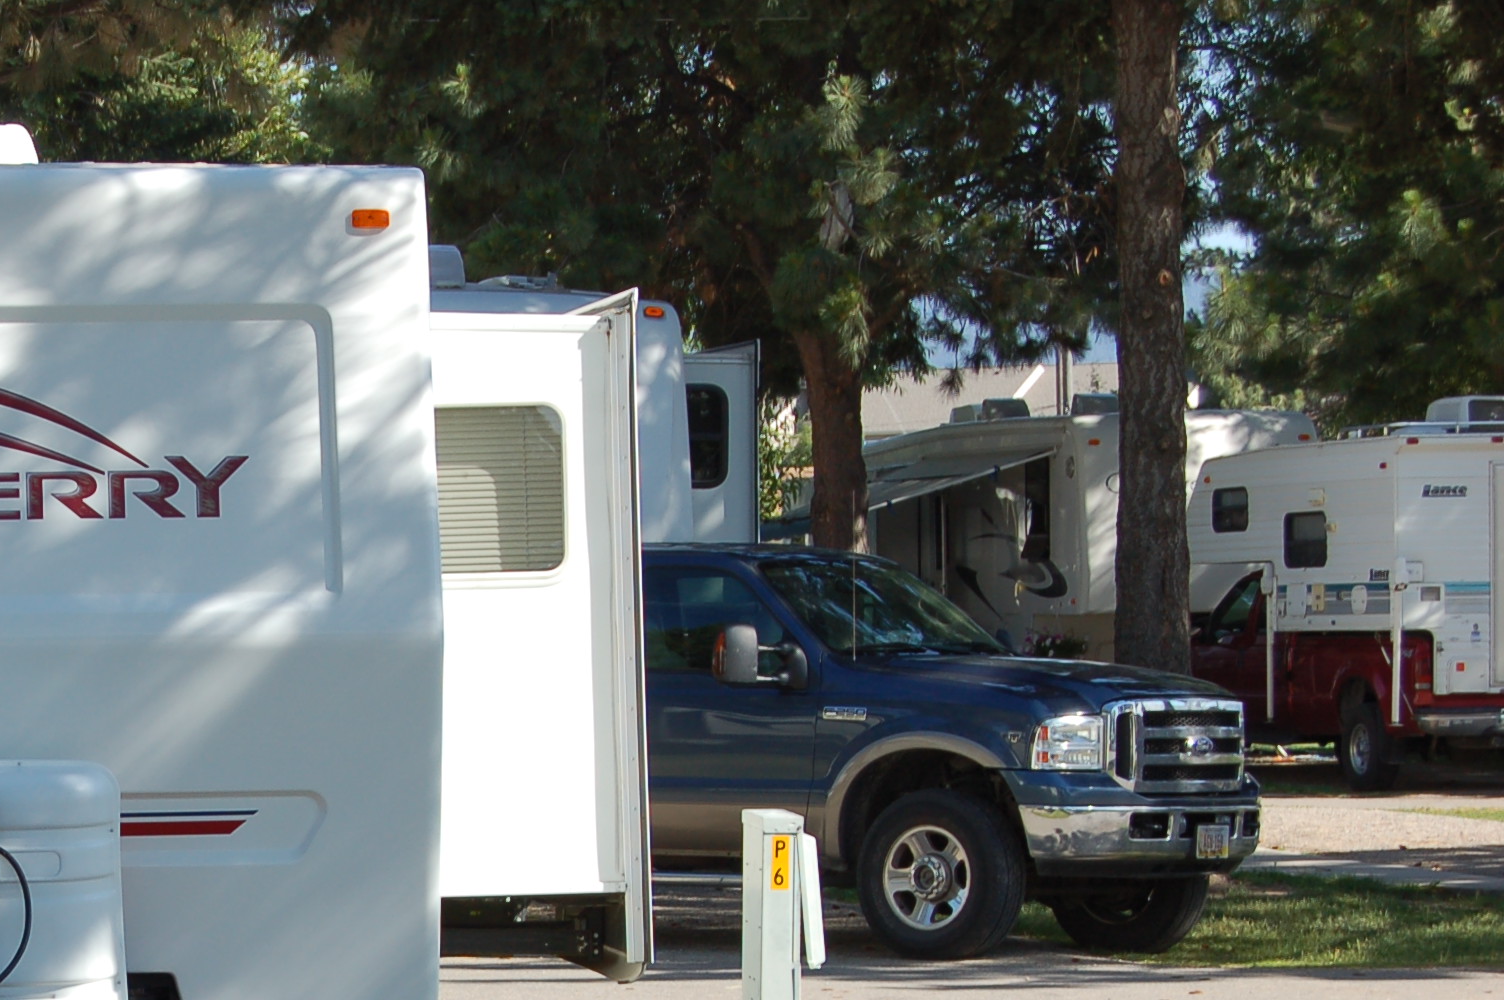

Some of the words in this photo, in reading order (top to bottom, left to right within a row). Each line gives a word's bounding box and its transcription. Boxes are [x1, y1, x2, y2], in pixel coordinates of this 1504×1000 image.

[1422, 484, 1468, 498] Lance
[775, 840, 786, 858] P
[774, 867, 784, 886] 6
